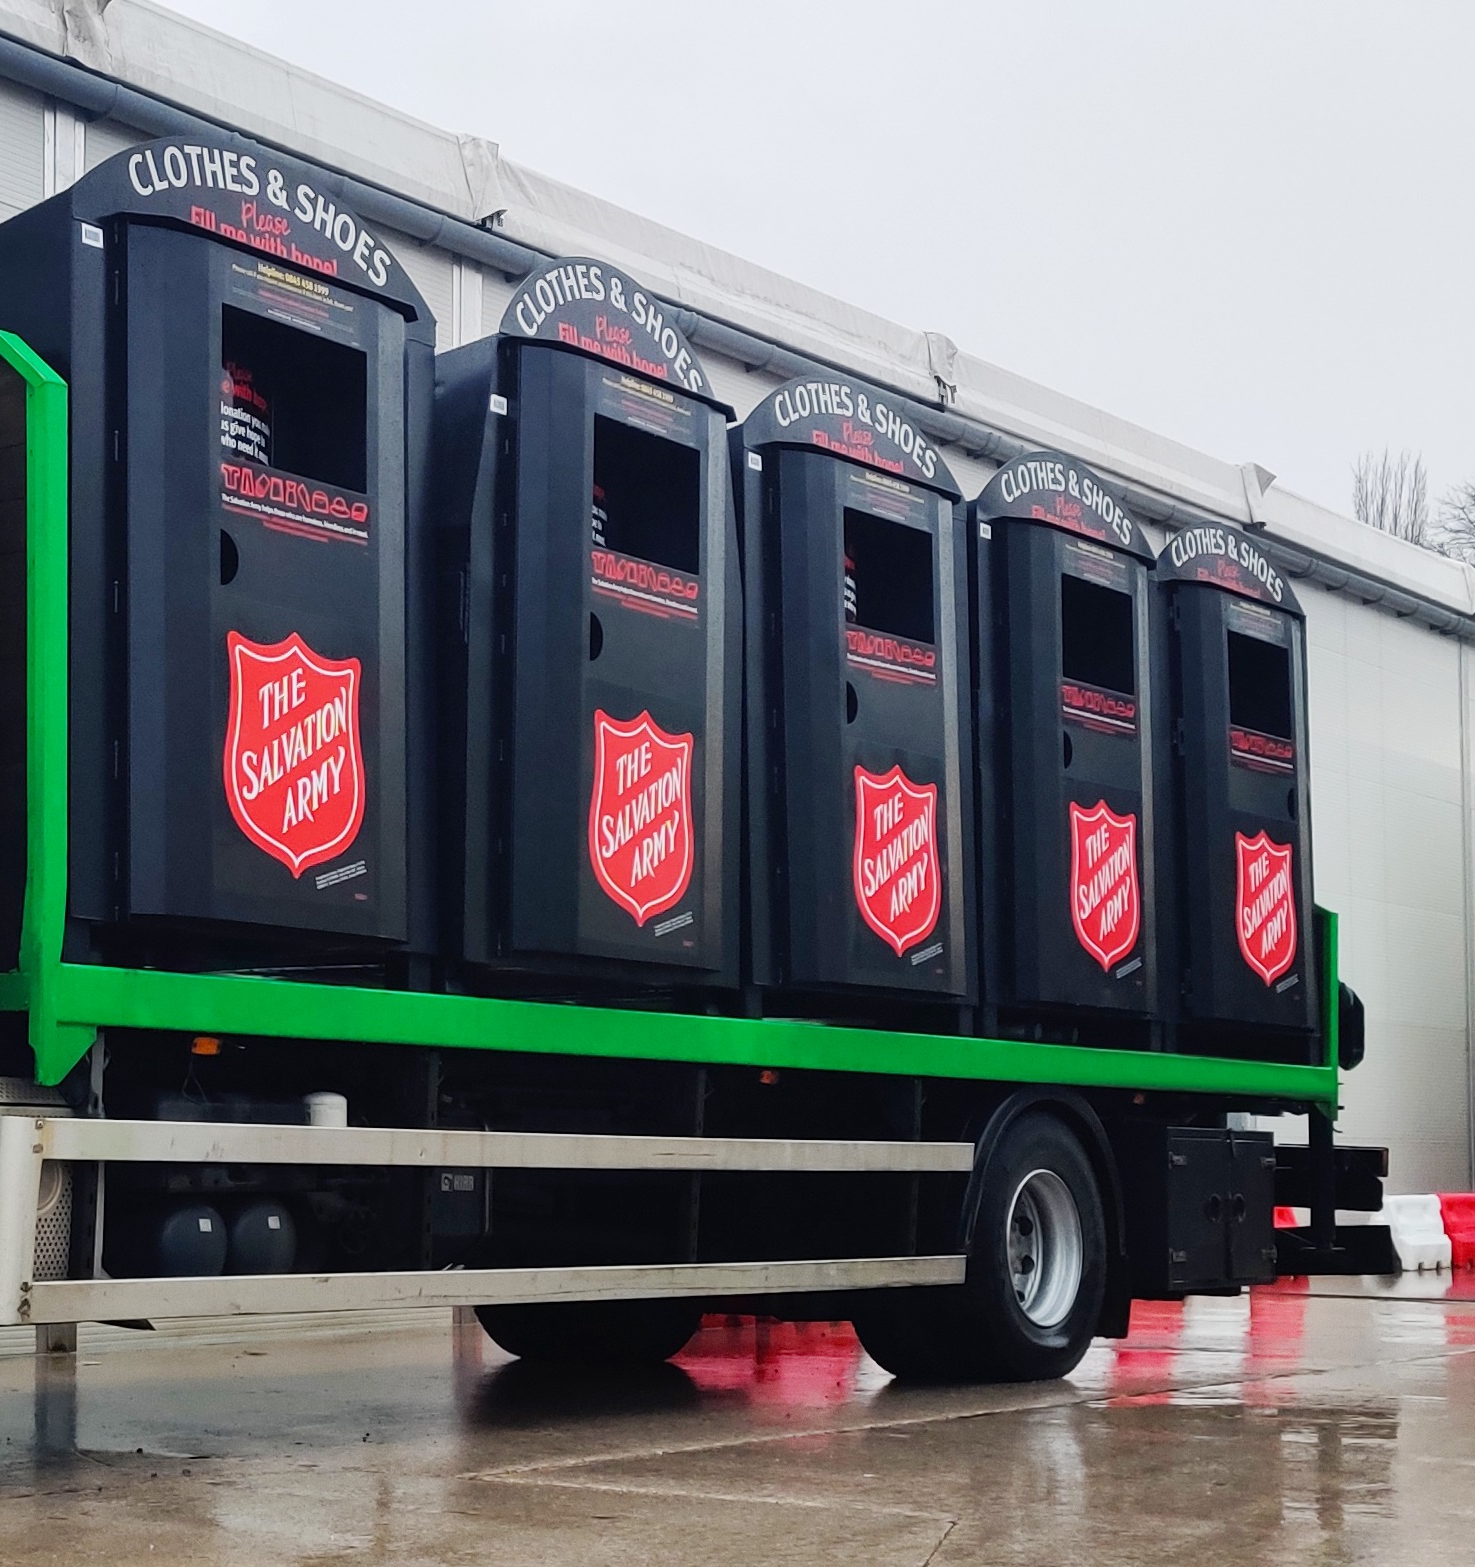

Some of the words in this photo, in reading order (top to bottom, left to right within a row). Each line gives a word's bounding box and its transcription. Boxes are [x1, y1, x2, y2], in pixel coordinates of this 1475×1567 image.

[128, 144, 260, 196] CLOTHES
[266, 169, 291, 212] &
[294, 184, 391, 287] SHOES
[190, 205, 216, 231] Fill
[250, 233, 288, 258] with
[241, 200, 291, 236] Please
[516, 264, 606, 336] CLOTHES
[610, 277, 630, 313] &
[632, 291, 703, 392] SHOES
[775, 383, 854, 427] CLOTHES
[858, 394, 874, 426] &
[874, 403, 938, 479] SHOES
[1001, 461, 1066, 502] CLOTHES
[1068, 469, 1081, 499] &
[1082, 478, 1132, 545] SHOES
[1171, 528, 1226, 567] CLOTHES
[1228, 534, 1239, 561] &
[1240, 541, 1284, 603] SHOES
[258, 667, 306, 730] THE
[241, 686, 347, 801] SALVATION
[616, 741, 652, 796] THE
[282, 745, 346, 834] ARMY
[602, 757, 681, 859] SALVATION
[874, 792, 904, 841] THE
[630, 810, 680, 888] ARMY
[864, 805, 929, 898] SALVATION
[1079, 834, 1130, 920] SALVATION
[1086, 823, 1109, 869] THE
[1248, 852, 1270, 892] THE
[890, 852, 928, 923] ARMY
[1099, 876, 1130, 941] ARMY
[1244, 862, 1288, 939] SALVATION
[1261, 900, 1288, 959] ARMY
